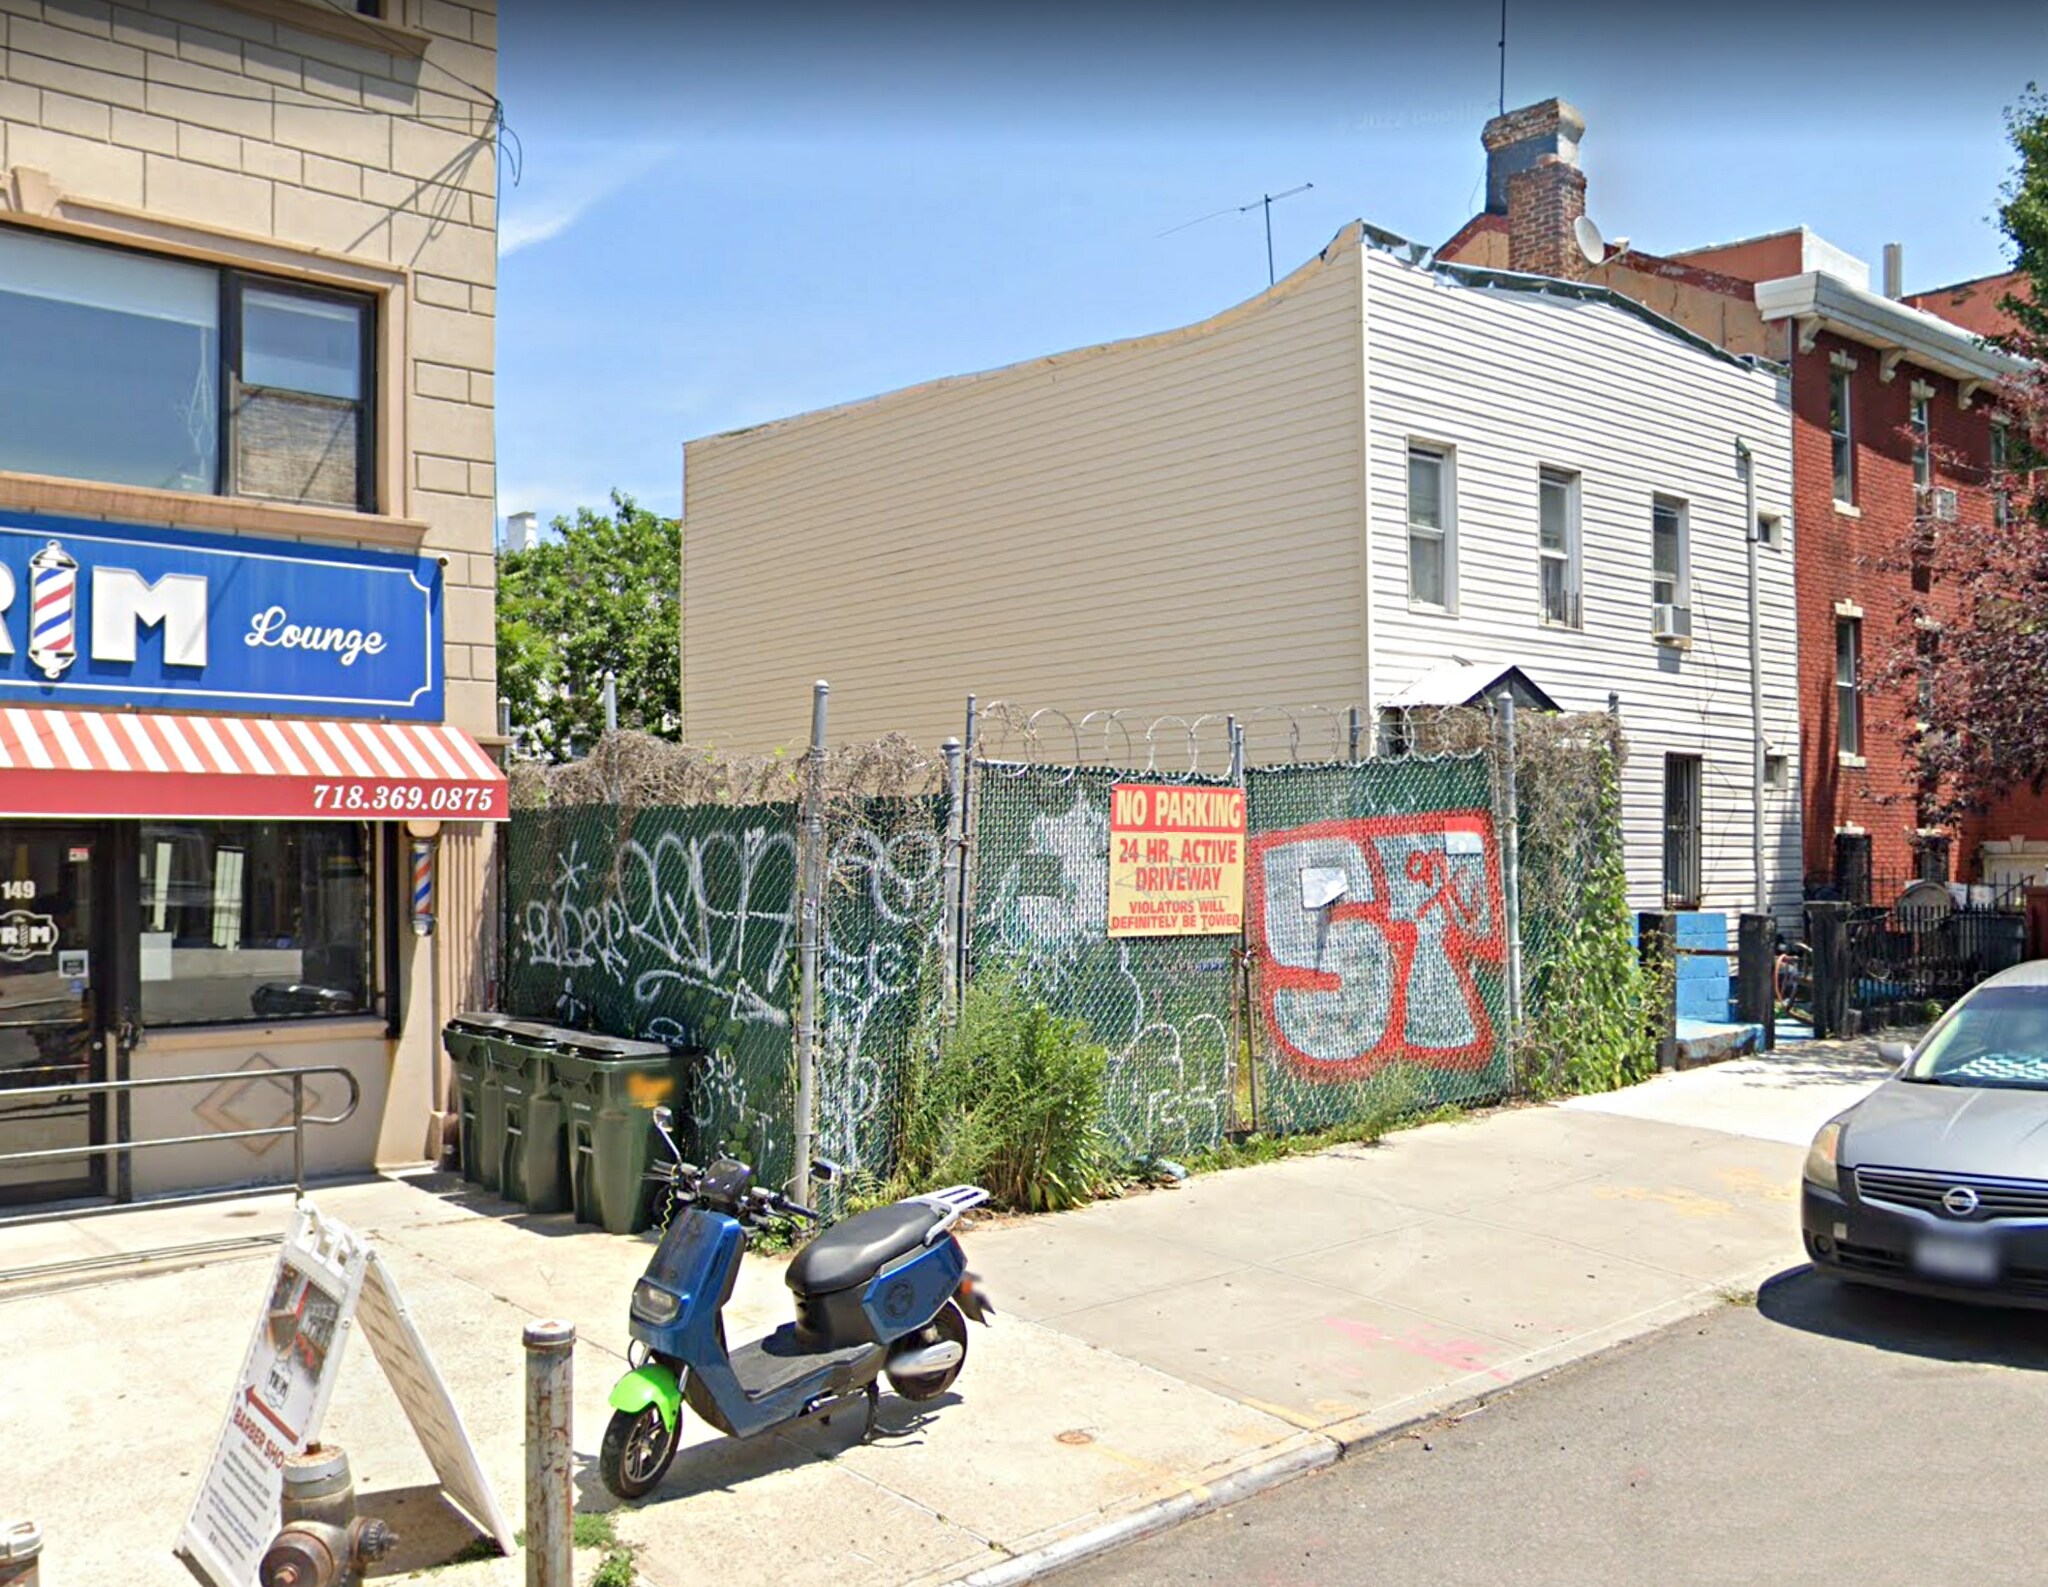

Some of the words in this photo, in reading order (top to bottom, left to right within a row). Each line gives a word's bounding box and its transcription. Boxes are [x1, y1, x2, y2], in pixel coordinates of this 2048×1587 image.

[244, 606, 387, 666] Lounge
[313, 785, 494, 811] 718.369.0875
[1116, 790, 1147, 826] NO
[1155, 791, 1241, 828] PARKING
[1119, 838, 1138, 863] 24
[1181, 840, 1237, 863] ACTIVE
[1, 880, 36, 899] 149
[1135, 867, 1222, 891] DRIVEWAY
[1129, 901, 1194, 914] VIOLATORS
[1200, 900, 1225, 912] WILL
[1112, 915, 1178, 929] DEFINITELY
[1182, 914, 1196, 927] BE
[1200, 913, 1239, 927] TOWED
[233, 1406, 266, 1451] BARBER
[264, 1438, 286, 1469] SHO
